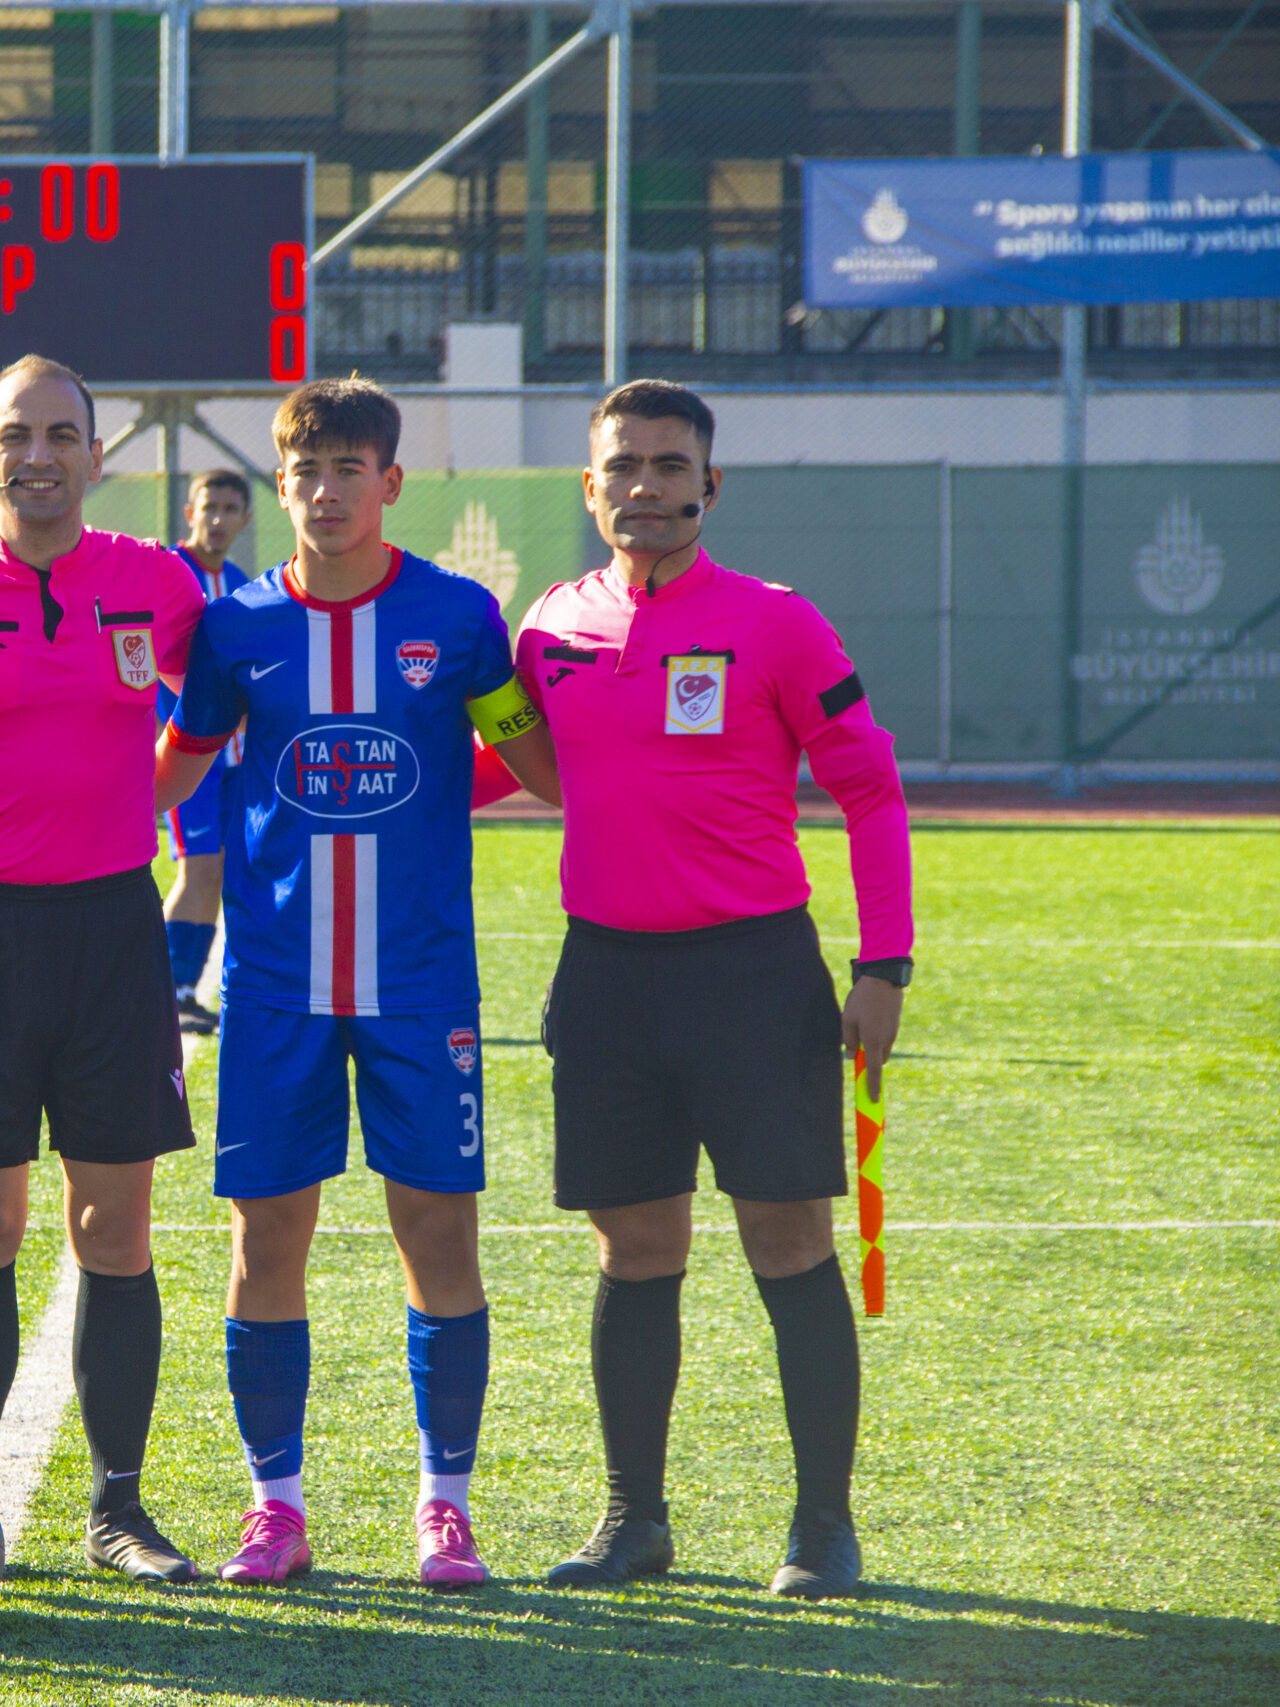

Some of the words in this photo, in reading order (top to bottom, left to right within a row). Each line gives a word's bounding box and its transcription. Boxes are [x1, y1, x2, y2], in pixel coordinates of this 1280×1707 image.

[270, 243, 306, 312] 0
[270, 315, 306, 383] 0
[127, 670, 149, 682] TFF
[459, 1093, 480, 1157] 3
